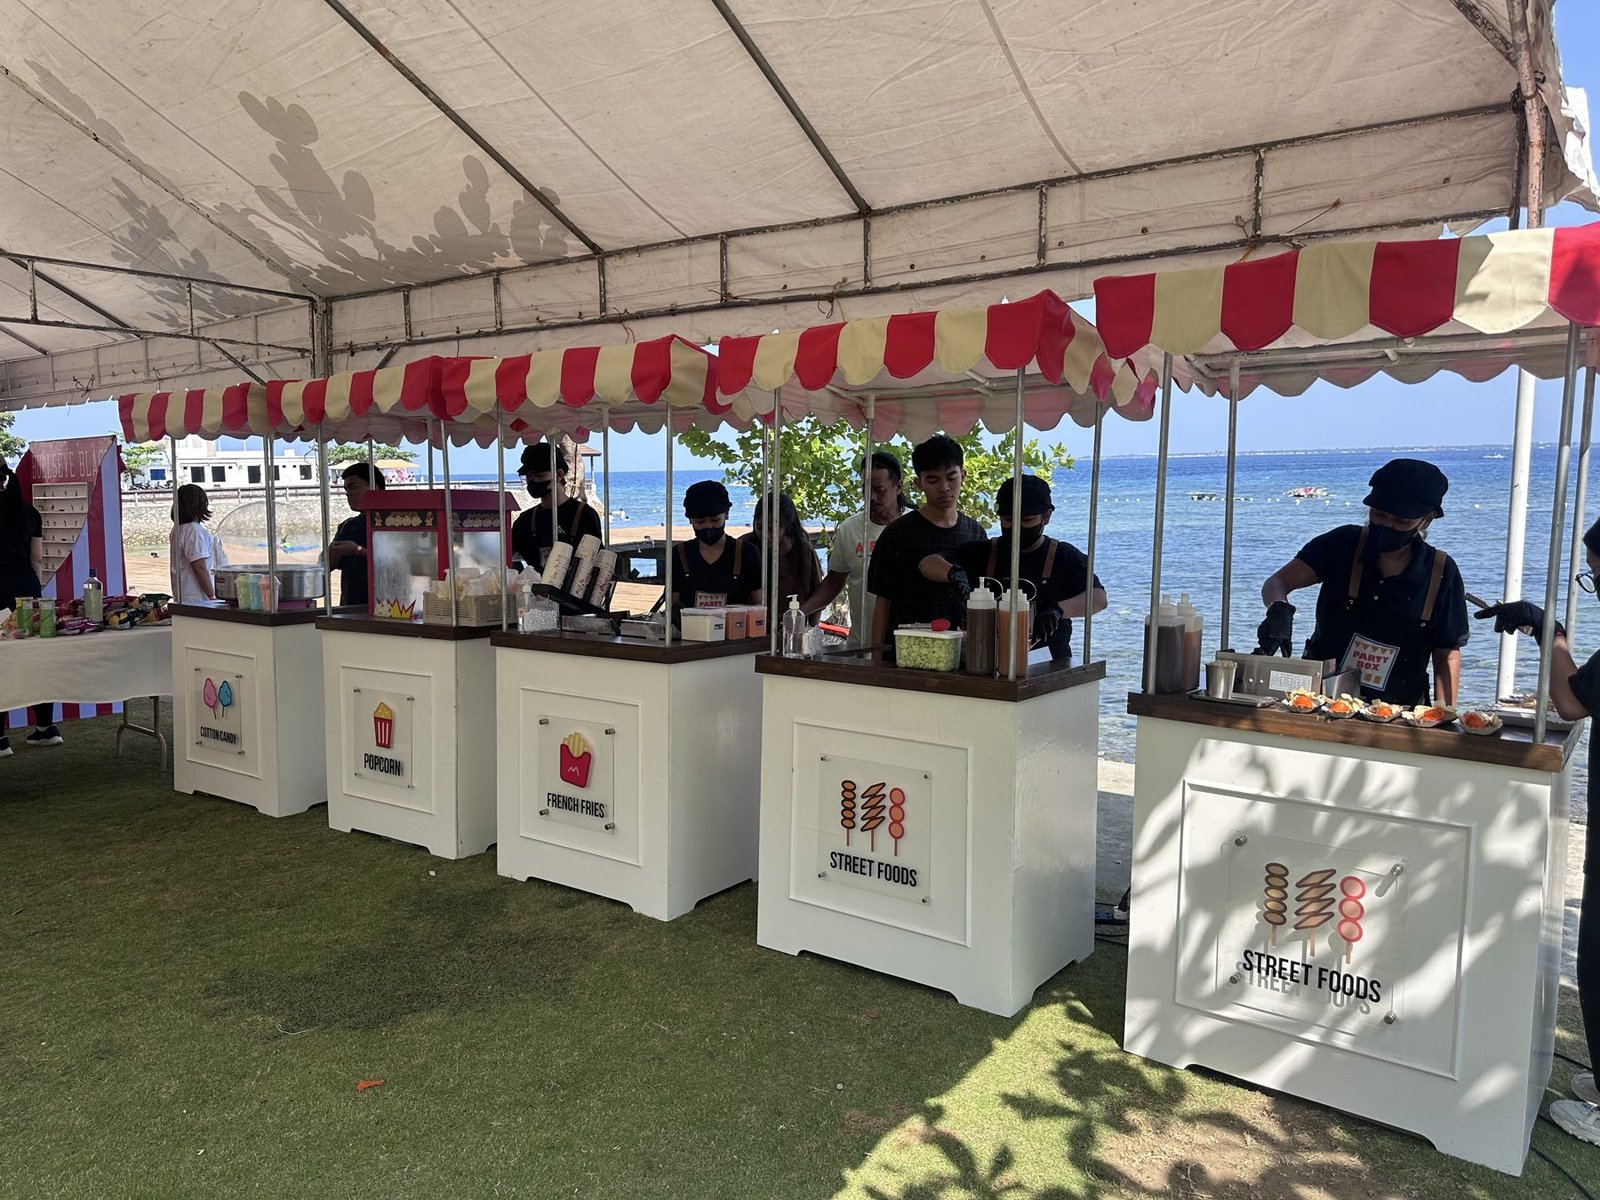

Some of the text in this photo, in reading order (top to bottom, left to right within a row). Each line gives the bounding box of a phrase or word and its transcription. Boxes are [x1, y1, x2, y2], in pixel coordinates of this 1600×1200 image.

[32, 451, 75, 479] BULLSEYE
[1352, 650, 1389, 663] PARTY
[1356, 660, 1380, 671] BOX
[200, 725, 237, 745] COTTON CANDY
[363, 753, 401, 777] POPCORN
[547, 792, 605, 818] FRENCH FRIES
[830, 851, 917, 887] STREET FOODS
[1242, 949, 1382, 1003] STREET FOODS
